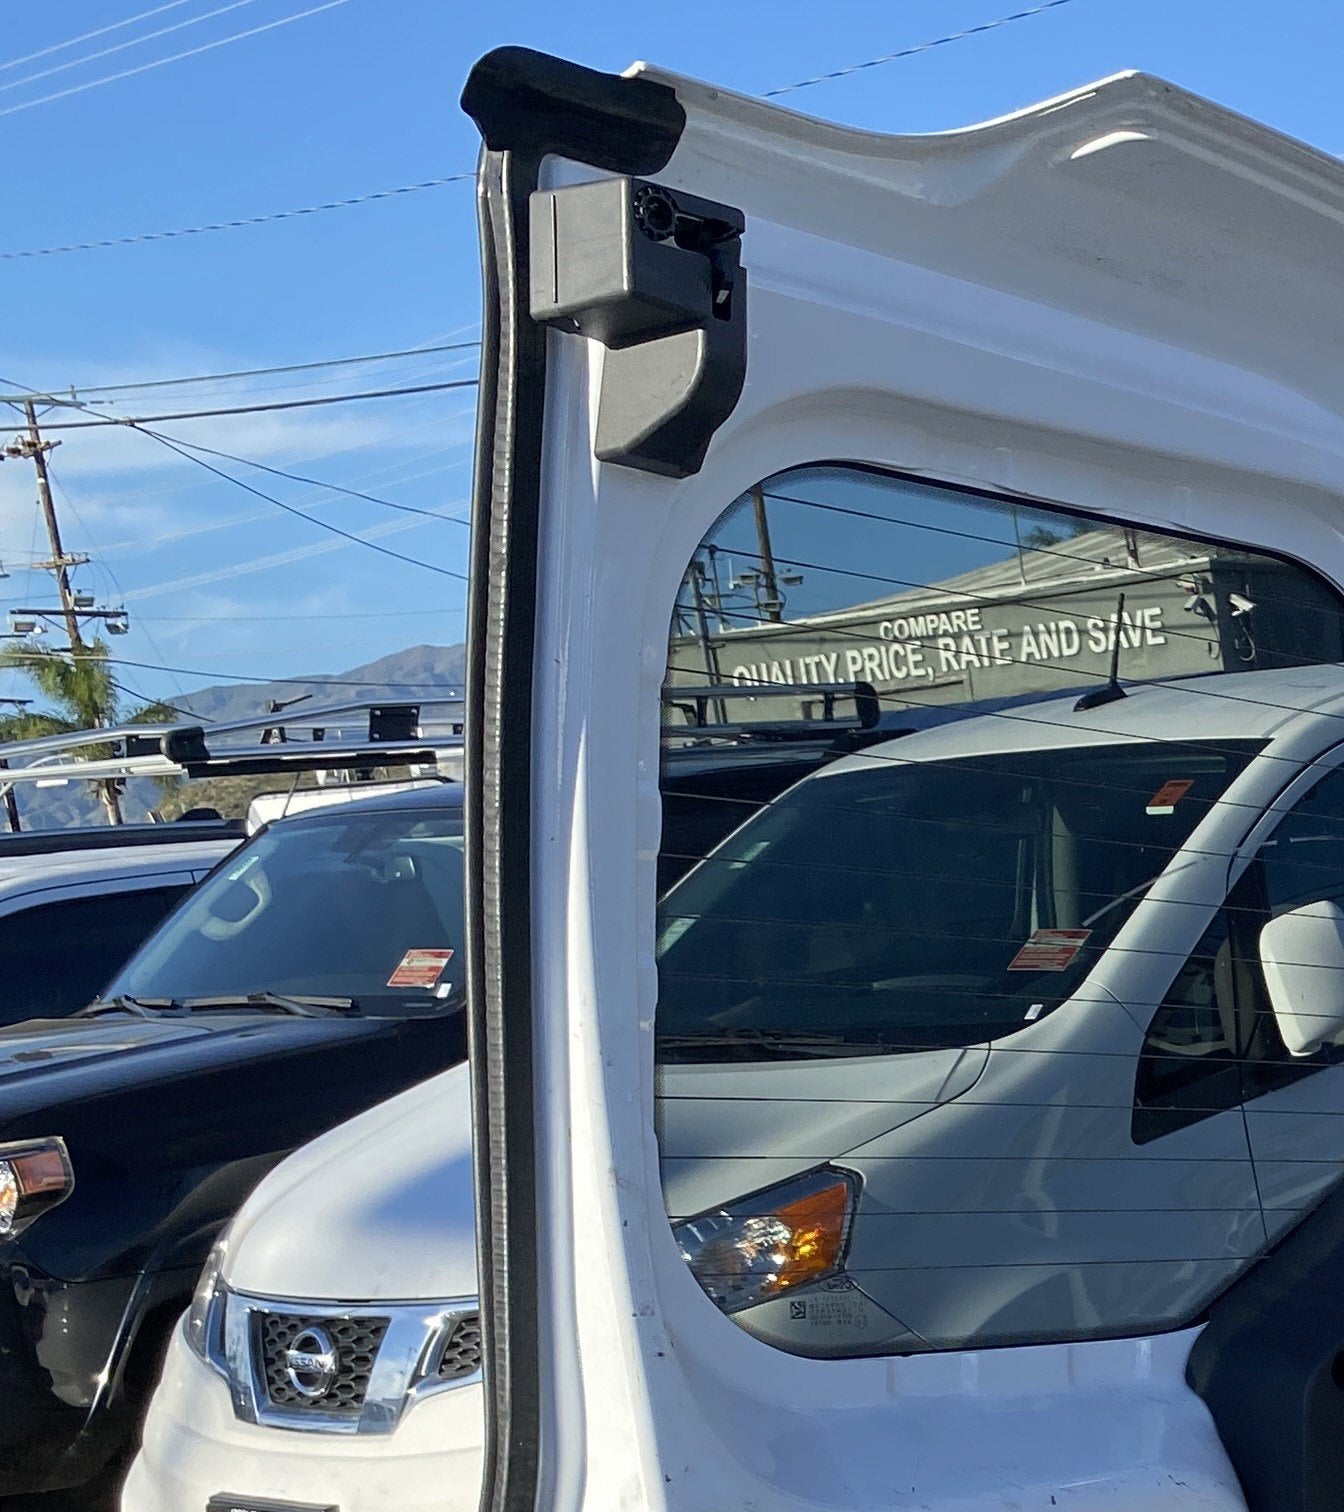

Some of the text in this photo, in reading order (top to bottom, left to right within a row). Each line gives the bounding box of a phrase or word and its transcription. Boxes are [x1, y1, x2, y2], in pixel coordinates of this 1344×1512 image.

[848, 640, 934, 682] PRICE,
[938, 628, 1014, 673] RATE
[1020, 619, 1082, 662] AND
[1087, 606, 1168, 653] SAVE
[879, 608, 983, 641] COMPARE
